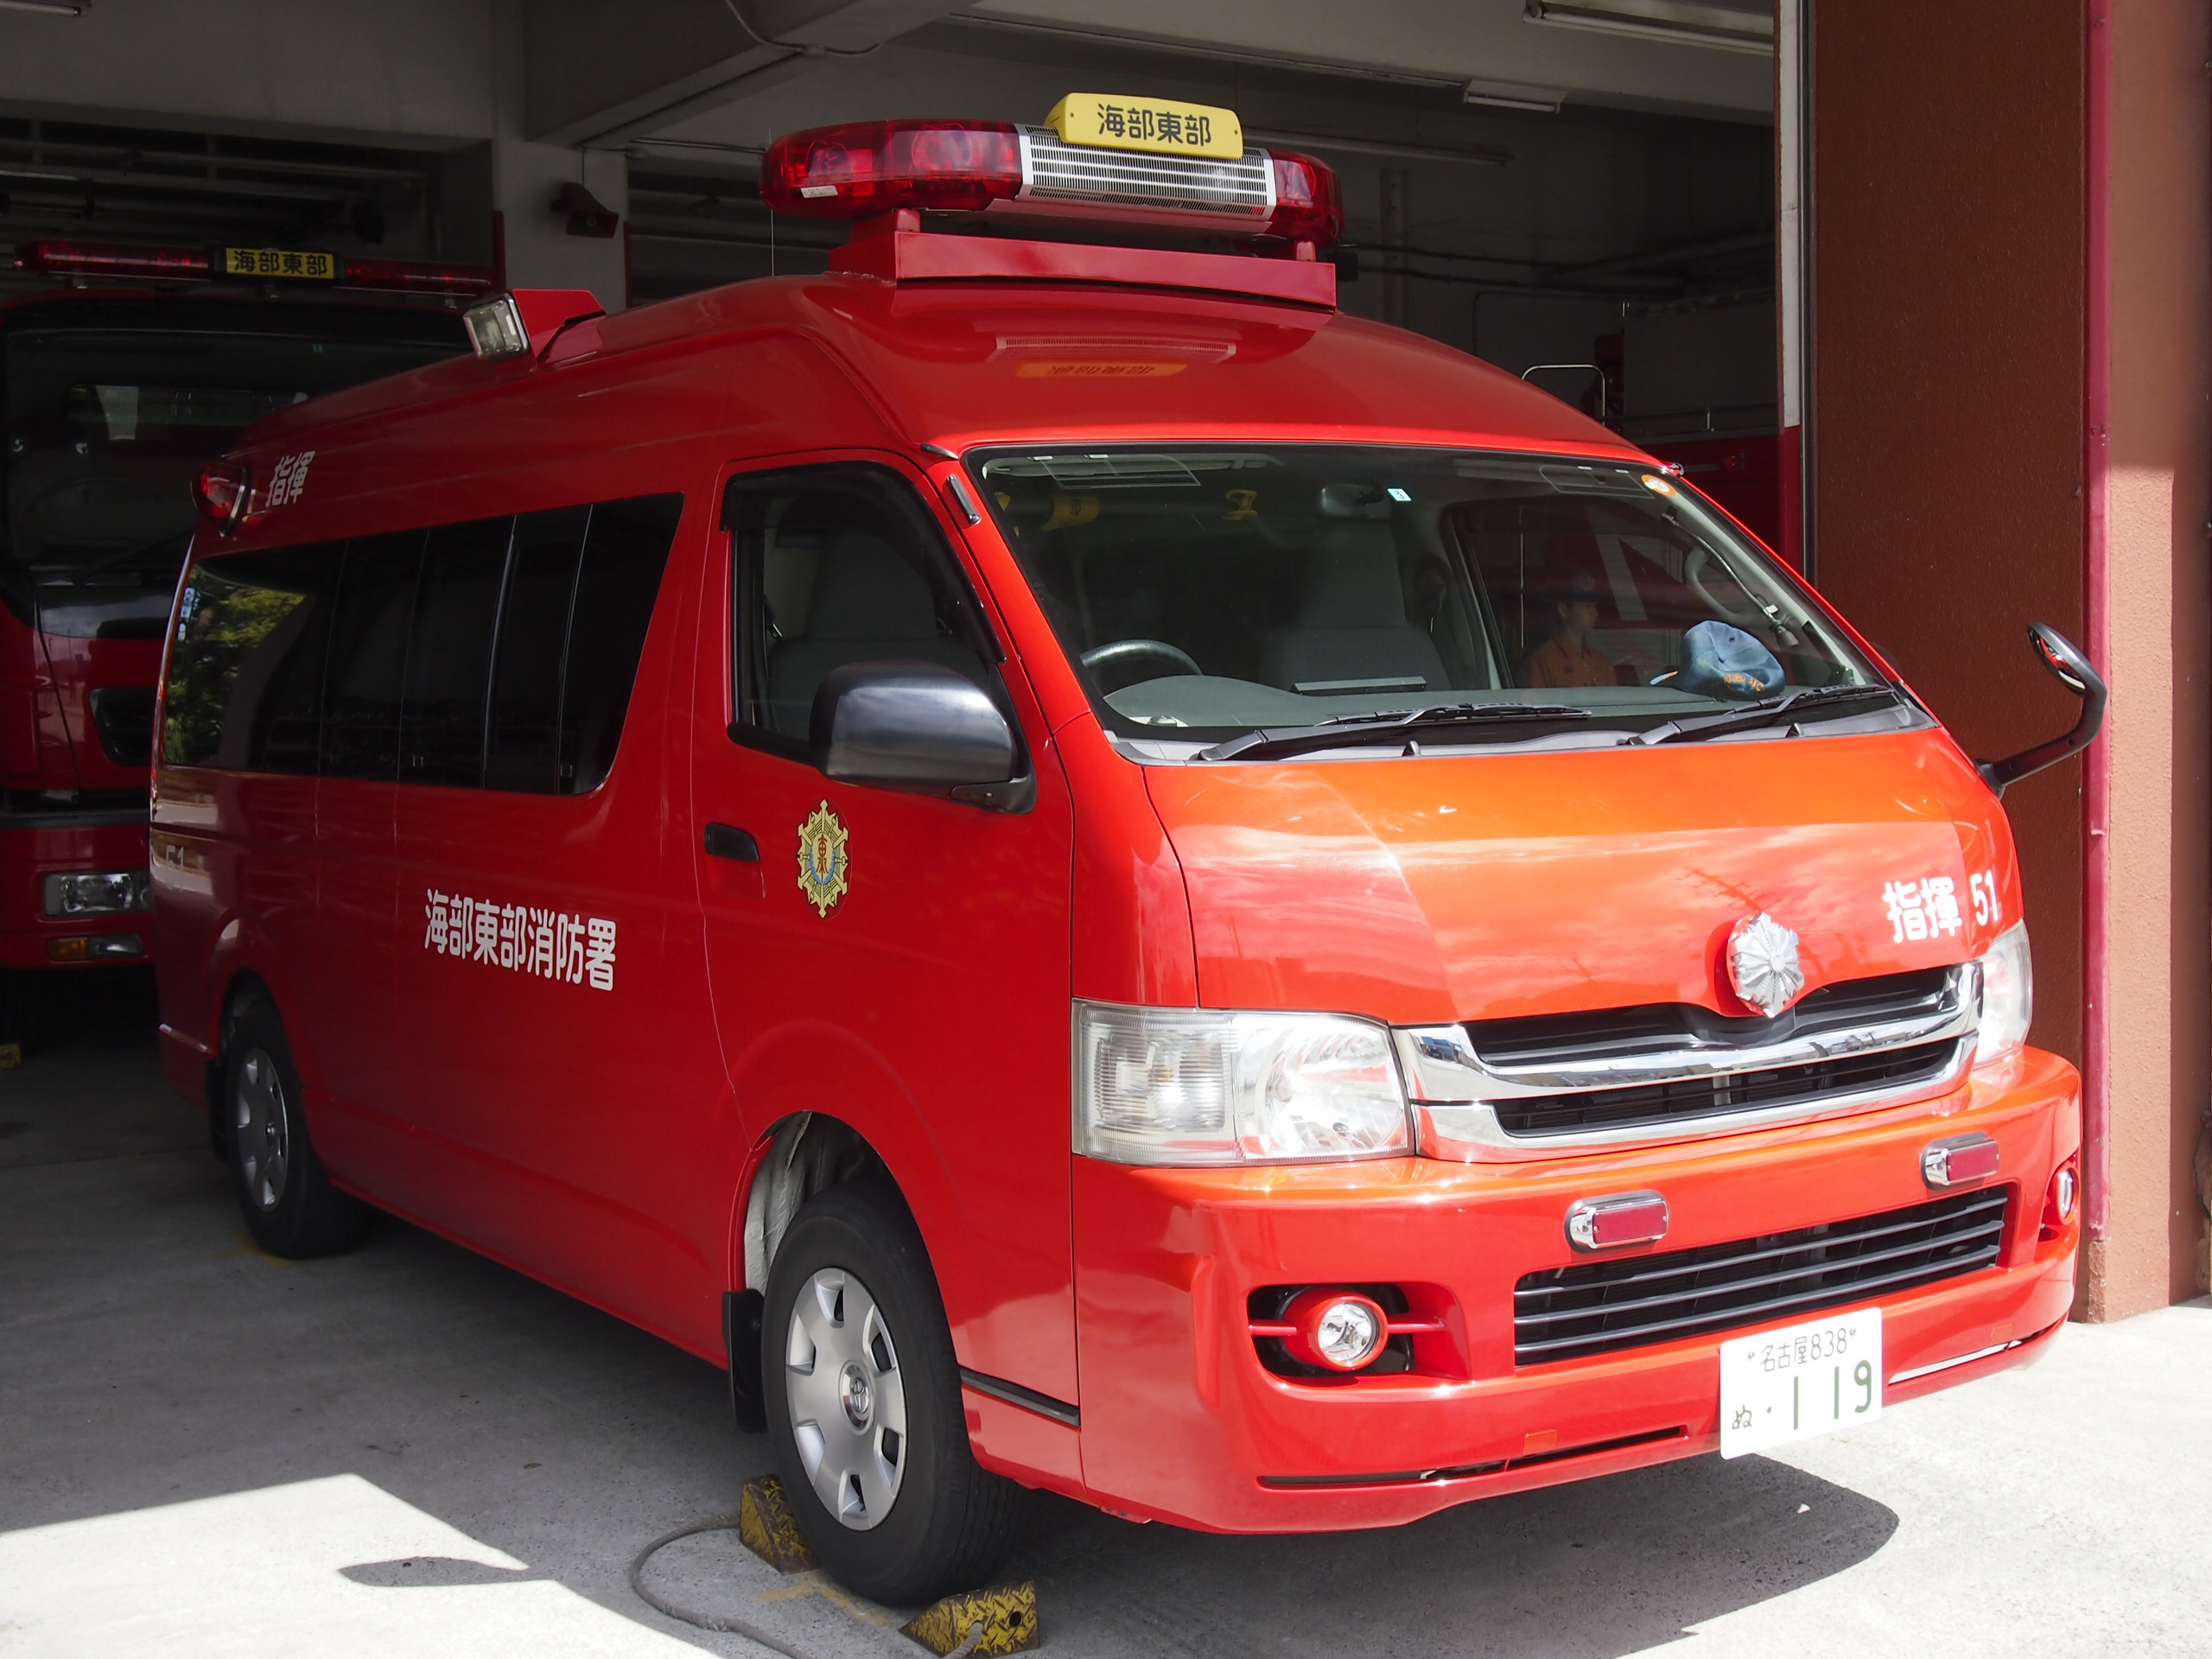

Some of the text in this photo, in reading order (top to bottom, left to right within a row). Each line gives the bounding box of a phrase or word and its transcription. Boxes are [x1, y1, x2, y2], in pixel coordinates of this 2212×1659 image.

[1096, 102, 1212, 147] 海部東部
[233, 249, 328, 276] 海部東部
[264, 450, 316, 508] 指揮
[1882, 869, 1999, 944] 指揮 51
[423, 887, 617, 992] 海部東部消防署
